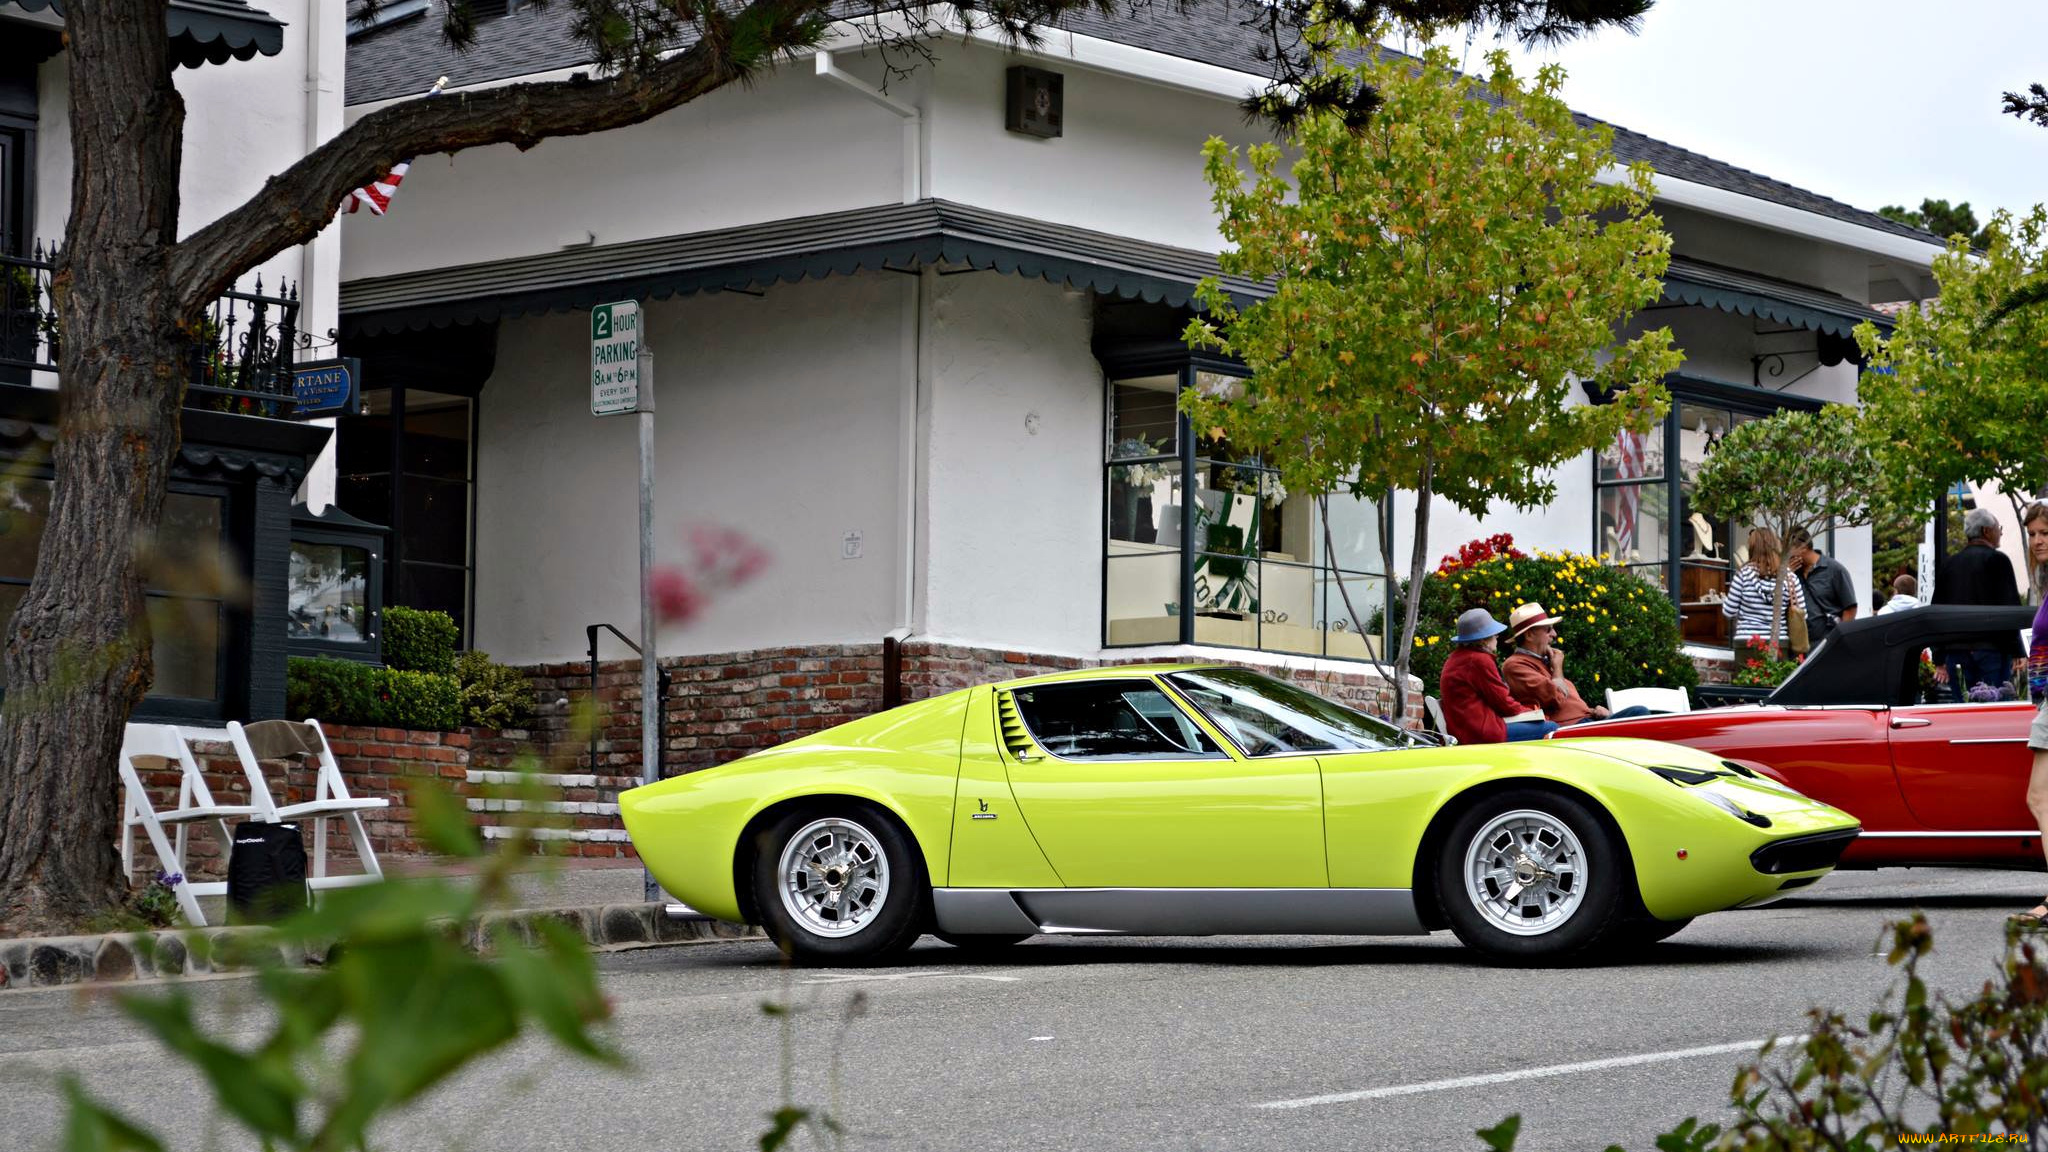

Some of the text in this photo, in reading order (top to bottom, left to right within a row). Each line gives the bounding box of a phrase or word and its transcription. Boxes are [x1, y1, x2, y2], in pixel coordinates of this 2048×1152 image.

[597, 311, 636, 335] 2 HOUR
[595, 340, 636, 365] PARKING
[293, 373, 341, 387] RTANE
[600, 386, 630, 397] EVERY DAY
